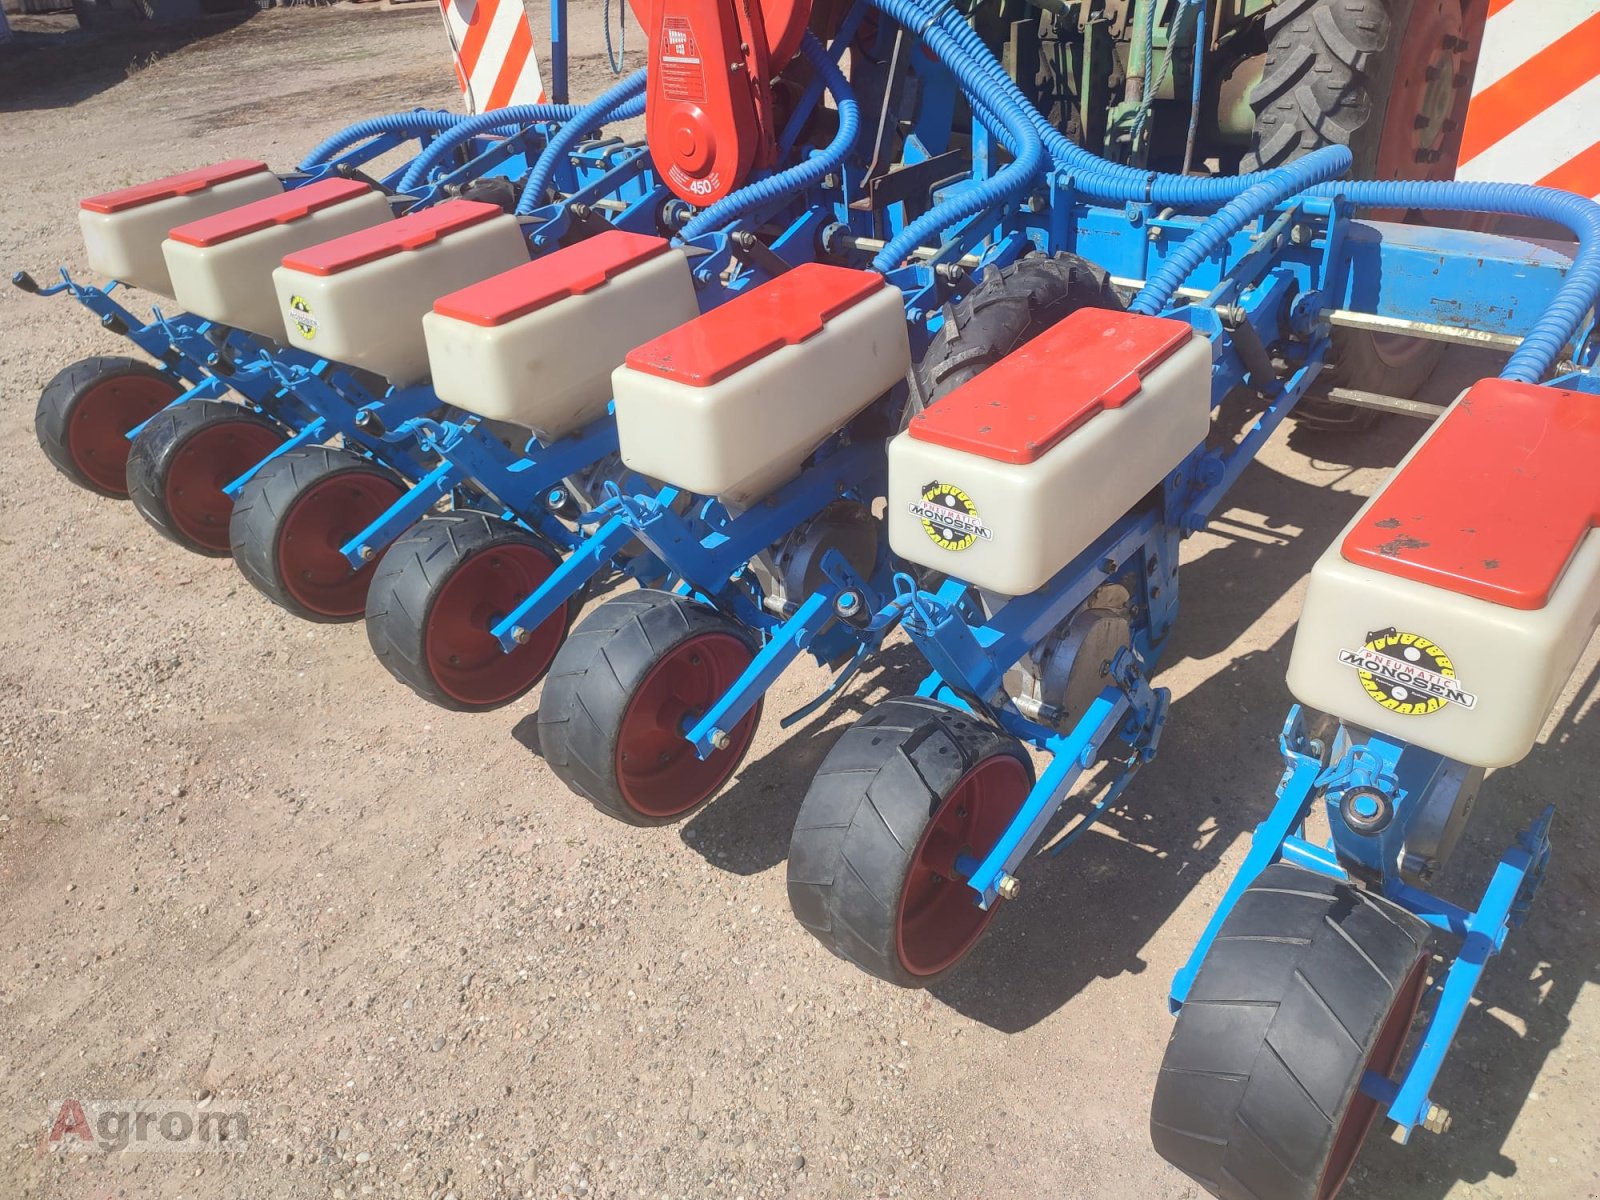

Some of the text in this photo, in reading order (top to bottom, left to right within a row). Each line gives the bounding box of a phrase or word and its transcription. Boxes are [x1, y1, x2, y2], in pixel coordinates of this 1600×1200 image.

[690, 180, 712, 195] 450
[912, 505, 988, 538] MONOSEM
[923, 503, 981, 525] PNEUMATIC
[1344, 654, 1467, 704] MONOSEM
[1366, 652, 1451, 688] PNEUMATIC
